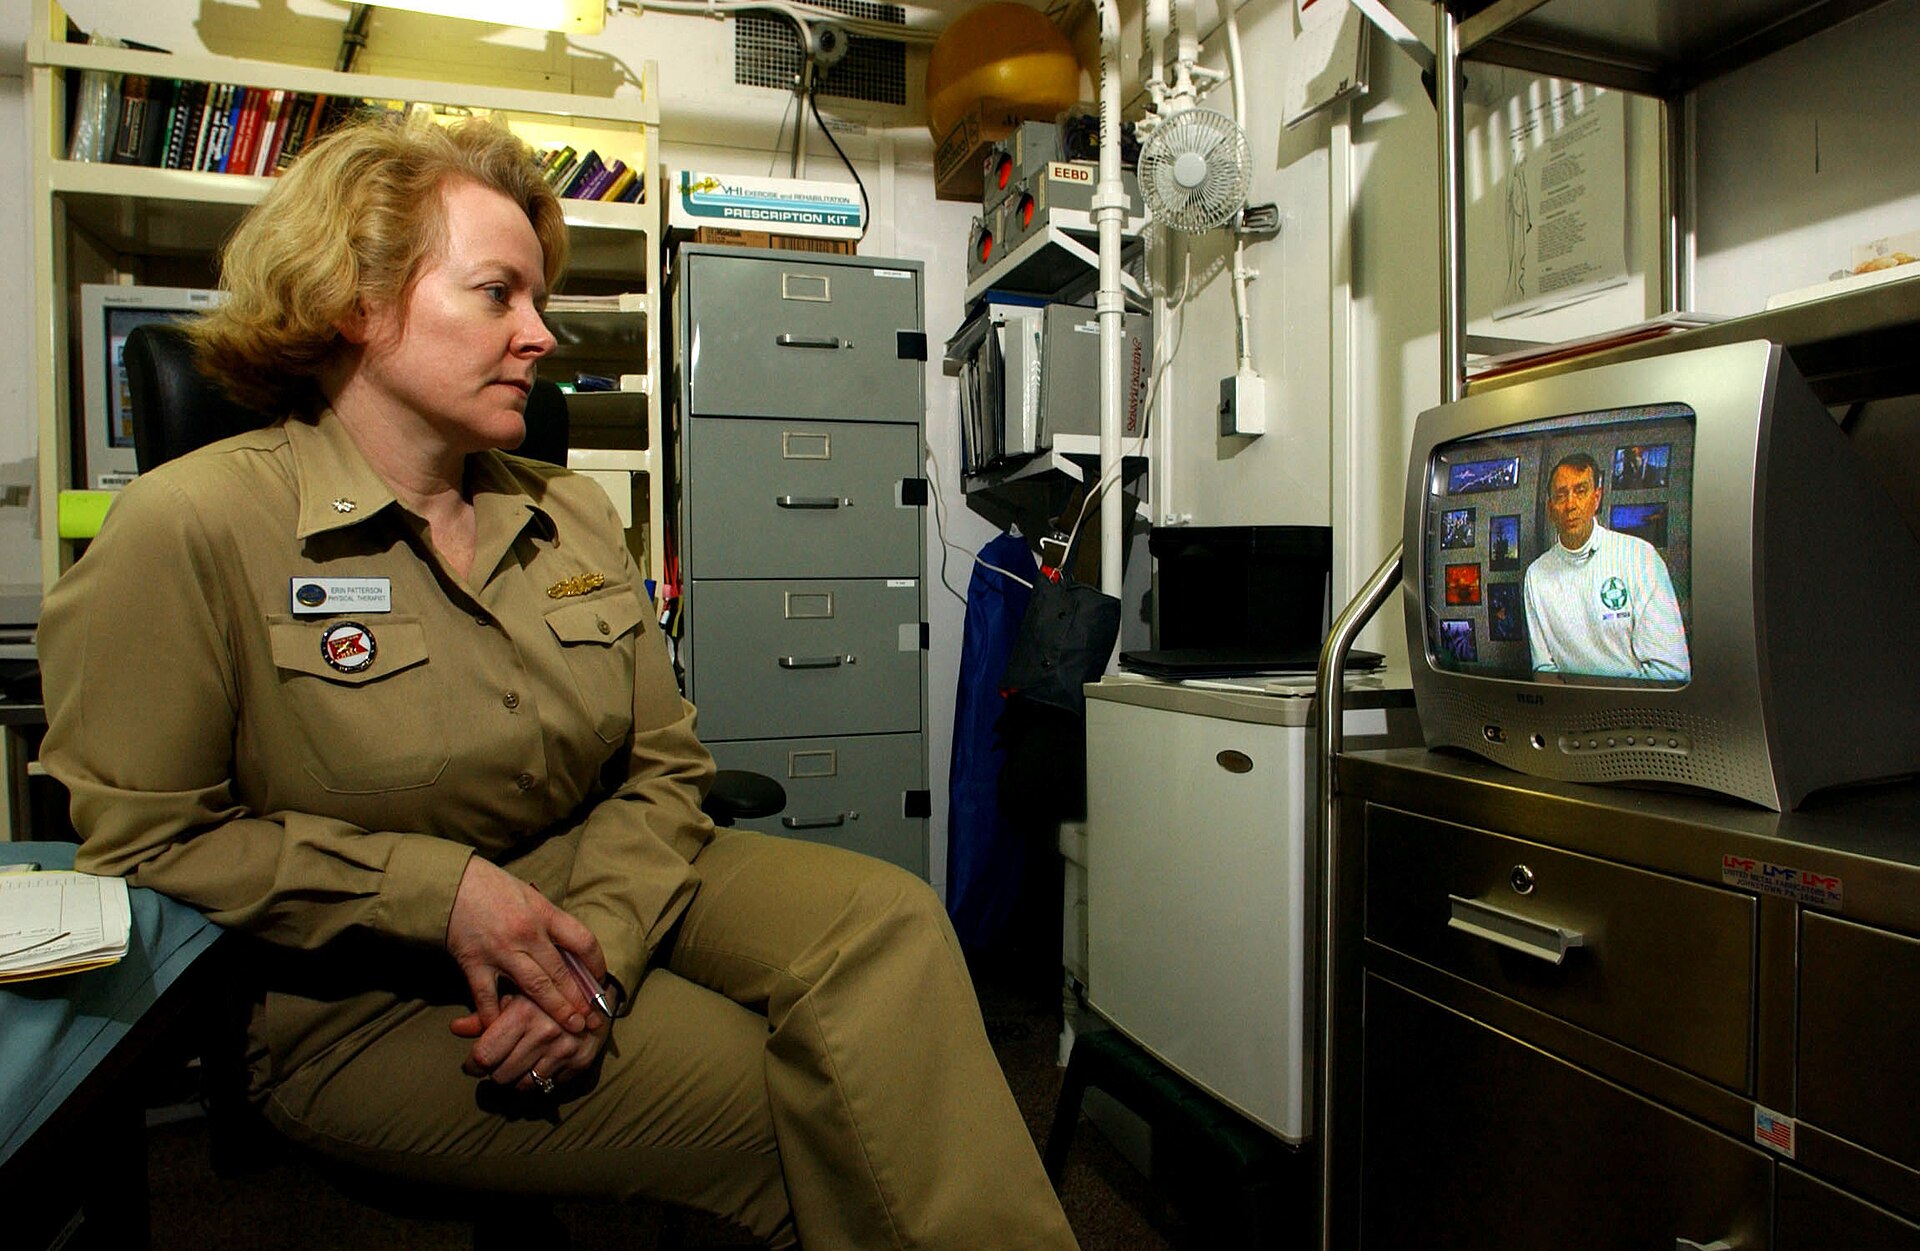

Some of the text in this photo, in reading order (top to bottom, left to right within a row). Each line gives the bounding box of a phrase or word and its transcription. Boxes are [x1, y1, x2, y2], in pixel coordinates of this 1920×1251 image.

[1055, 167, 1089, 181] EEBD
[744, 190, 778, 199] EXERCISE
[794, 194, 850, 204] REHABILITATION
[724, 208, 848, 225] PRESCRIPTION KIT
